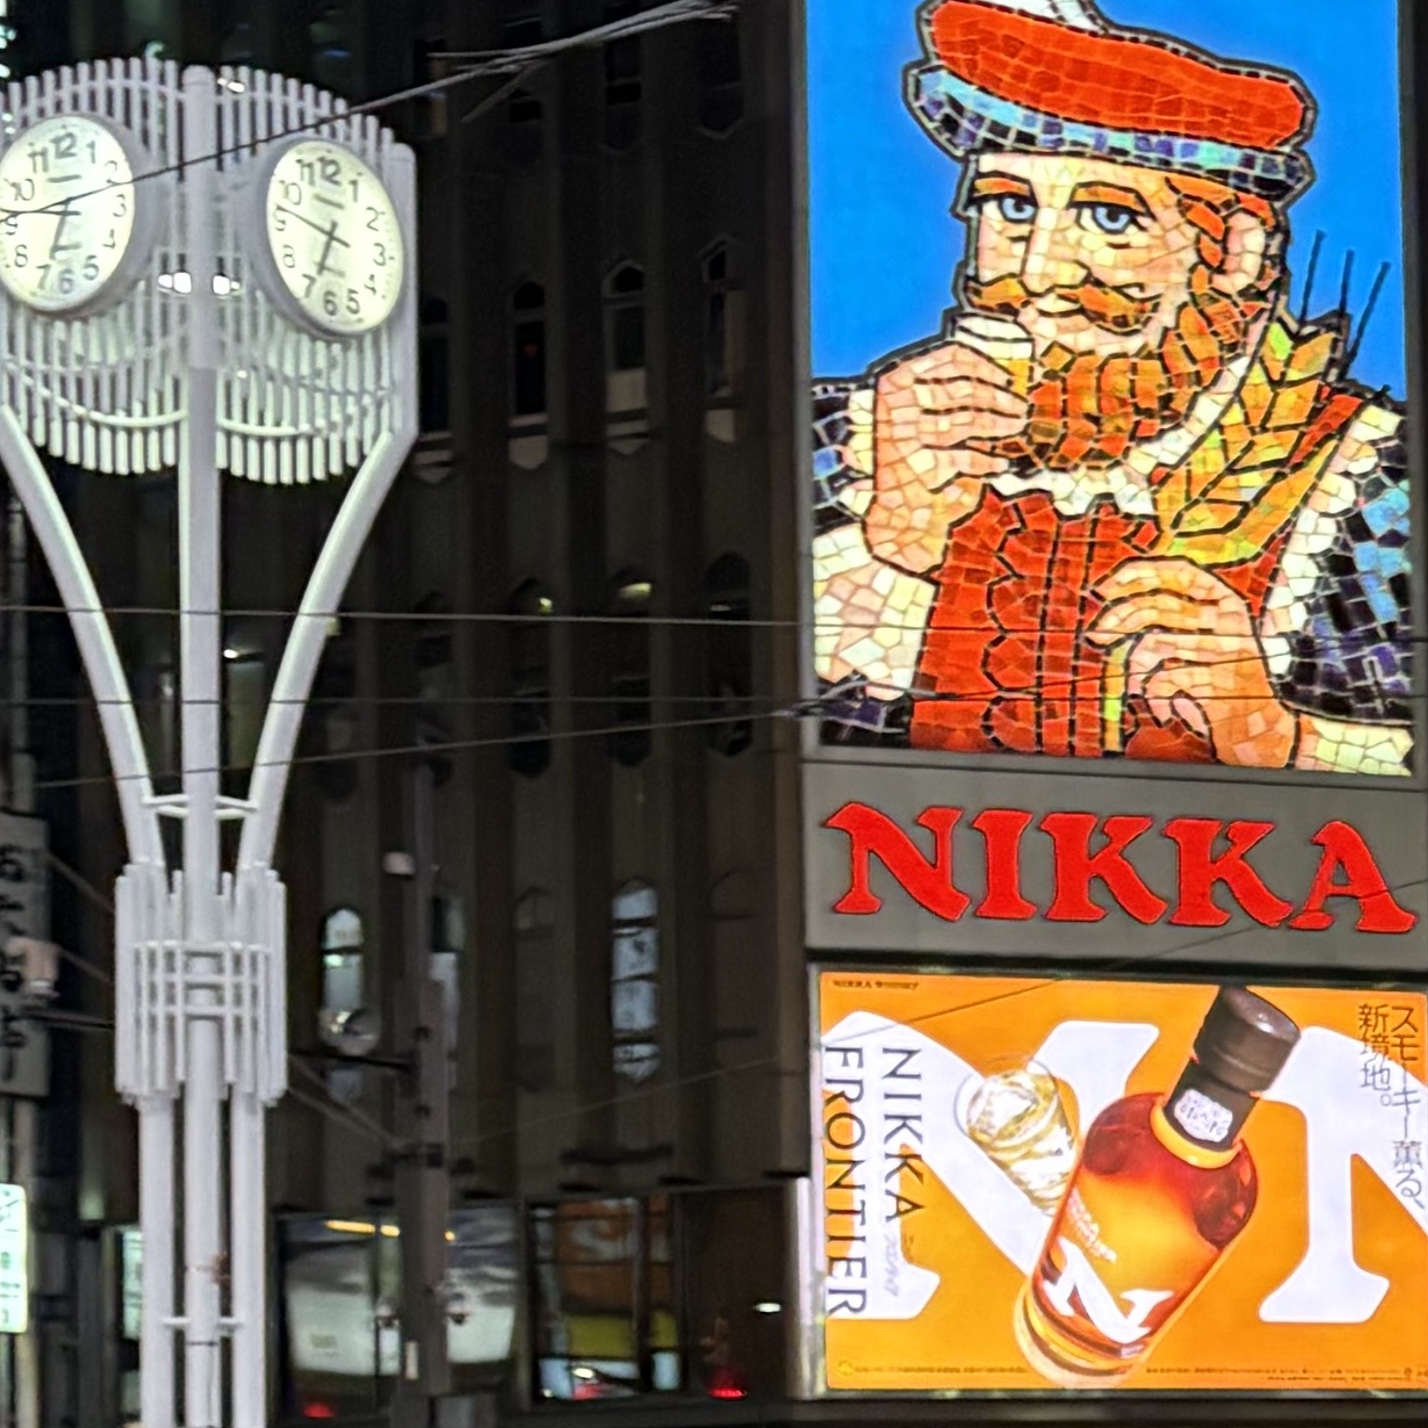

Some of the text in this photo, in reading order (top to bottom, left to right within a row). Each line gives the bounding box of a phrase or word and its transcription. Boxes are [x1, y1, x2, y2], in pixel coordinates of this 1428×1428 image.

[51, 132, 77, 159] 12
[86, 140, 96, 164] 1
[28, 147, 49, 173] 11
[296, 159, 315, 186] 11
[317, 156, 342, 186] 12
[4, 178, 35, 201] 10
[349, 179, 359, 203] 1
[113, 194, 127, 217] 3
[366, 207, 380, 232] 2
[14, 243, 29, 268] 8
[283, 244, 295, 268] 8
[373, 242, 387, 266] 3
[36, 264, 51, 290] 7
[83, 255, 100, 280] 5
[58, 268, 75, 294] 6
[302, 273, 317, 298] 7
[323, 290, 338, 316] 6
[346, 288, 360, 315] 5
[825, 801, 1419, 934] NIKKA
[882, 1047, 925, 1222] NIKKA
[825, 1047, 867, 1315] FRONTIER
